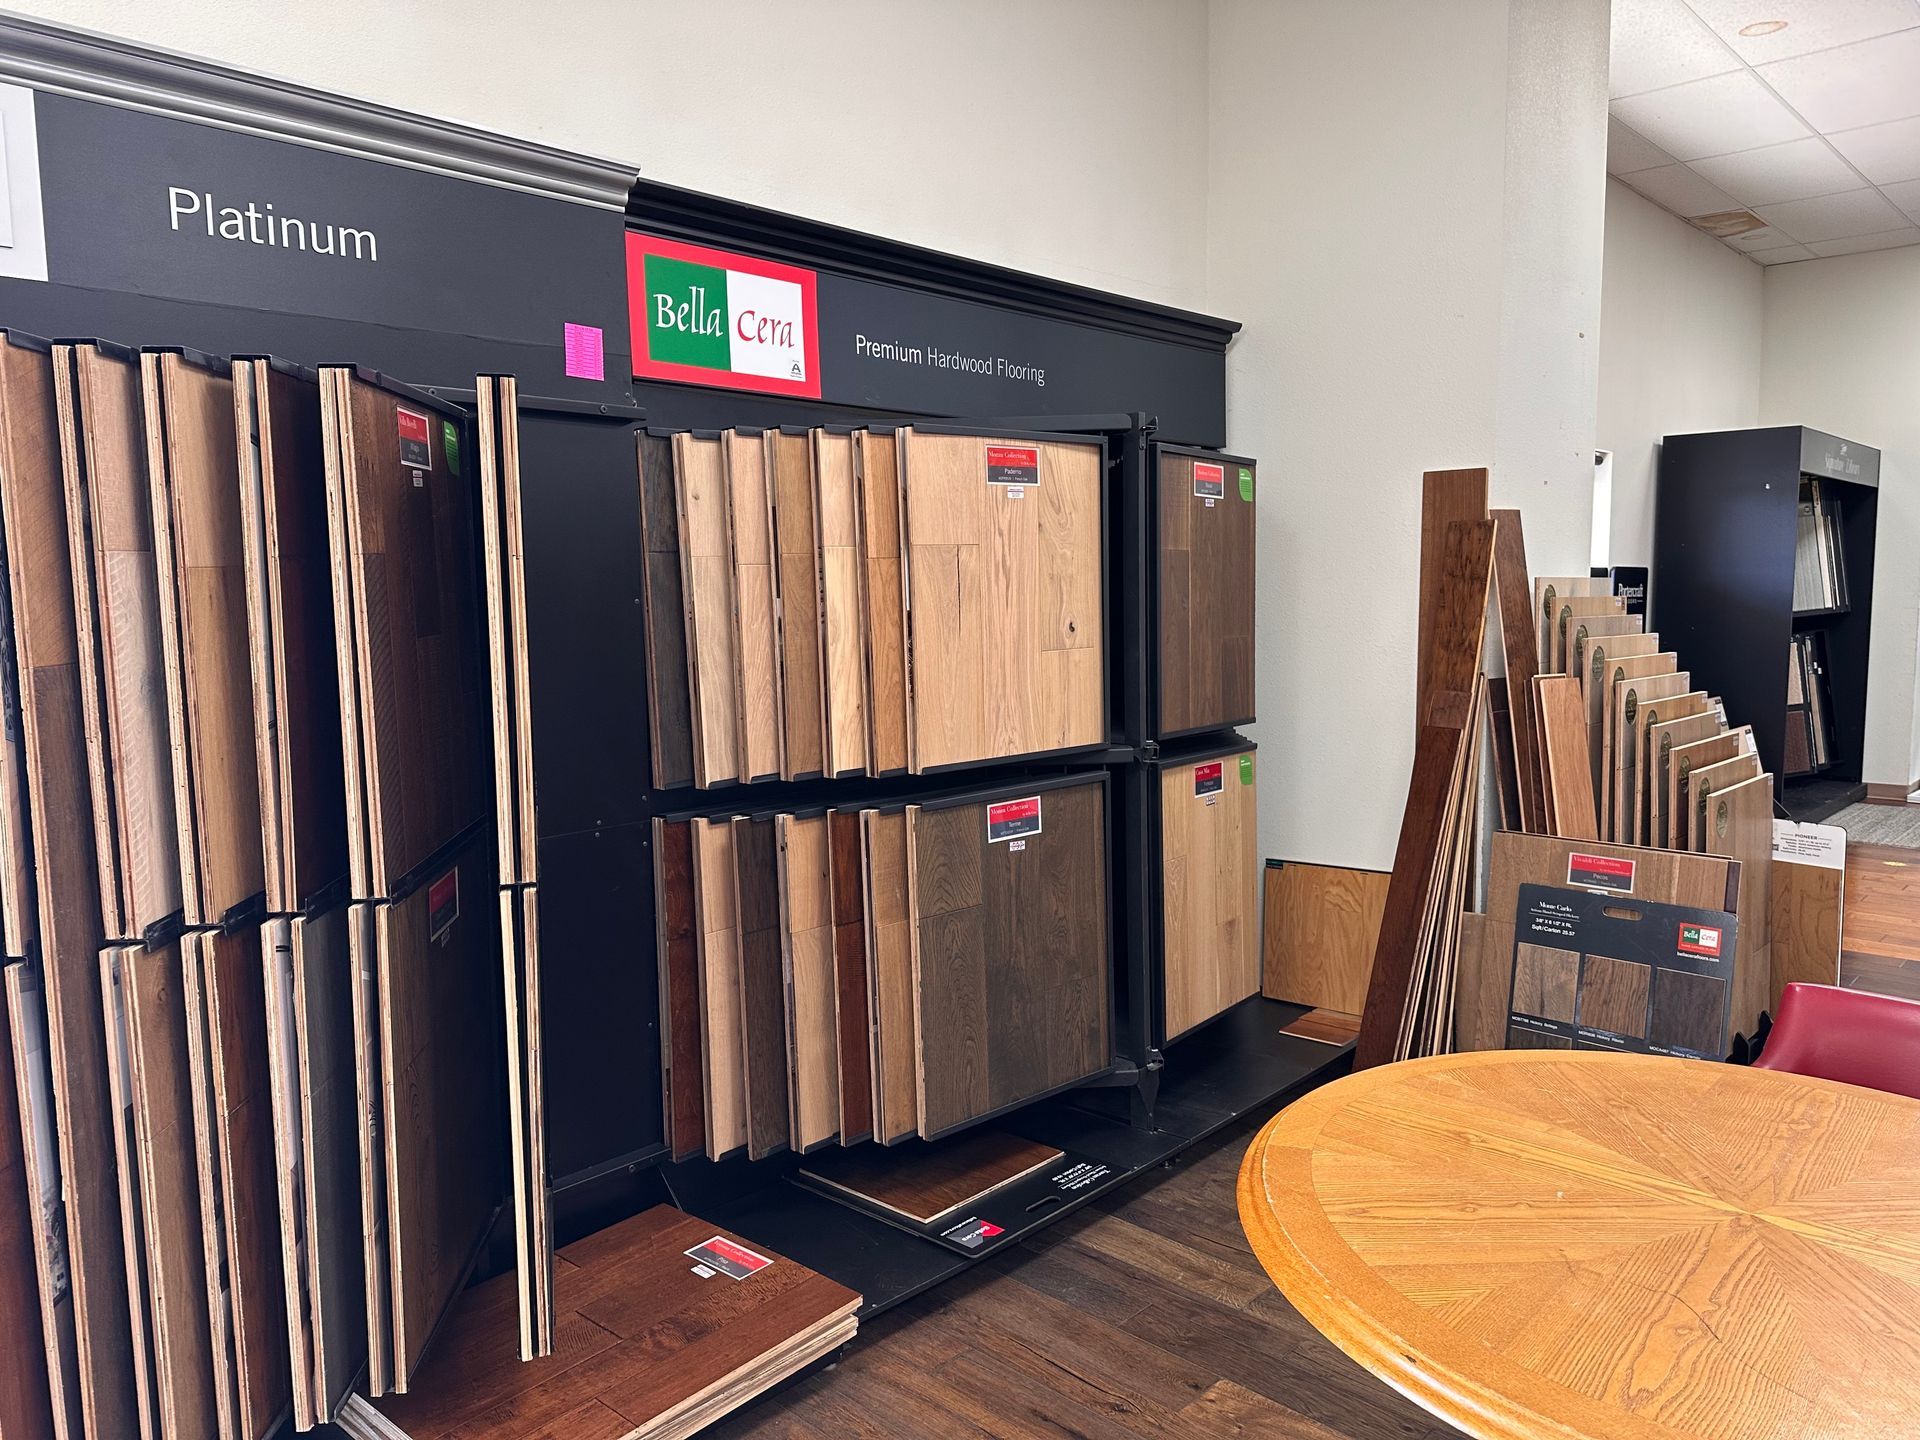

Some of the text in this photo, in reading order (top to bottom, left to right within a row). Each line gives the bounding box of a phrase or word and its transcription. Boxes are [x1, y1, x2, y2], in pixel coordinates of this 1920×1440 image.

[168, 186, 377, 262] Platinum
[653, 286, 795, 348] Bella Cera
[856, 334, 1045, 387] Premium Hardwood Flooring
[1593, 858, 1620, 867] Collection
[1539, 900, 1572, 912] Monte Carlo
[1531, 923, 1561, 934] Sqft/Carton
[1683, 930, 1716, 942] Bella Cera
